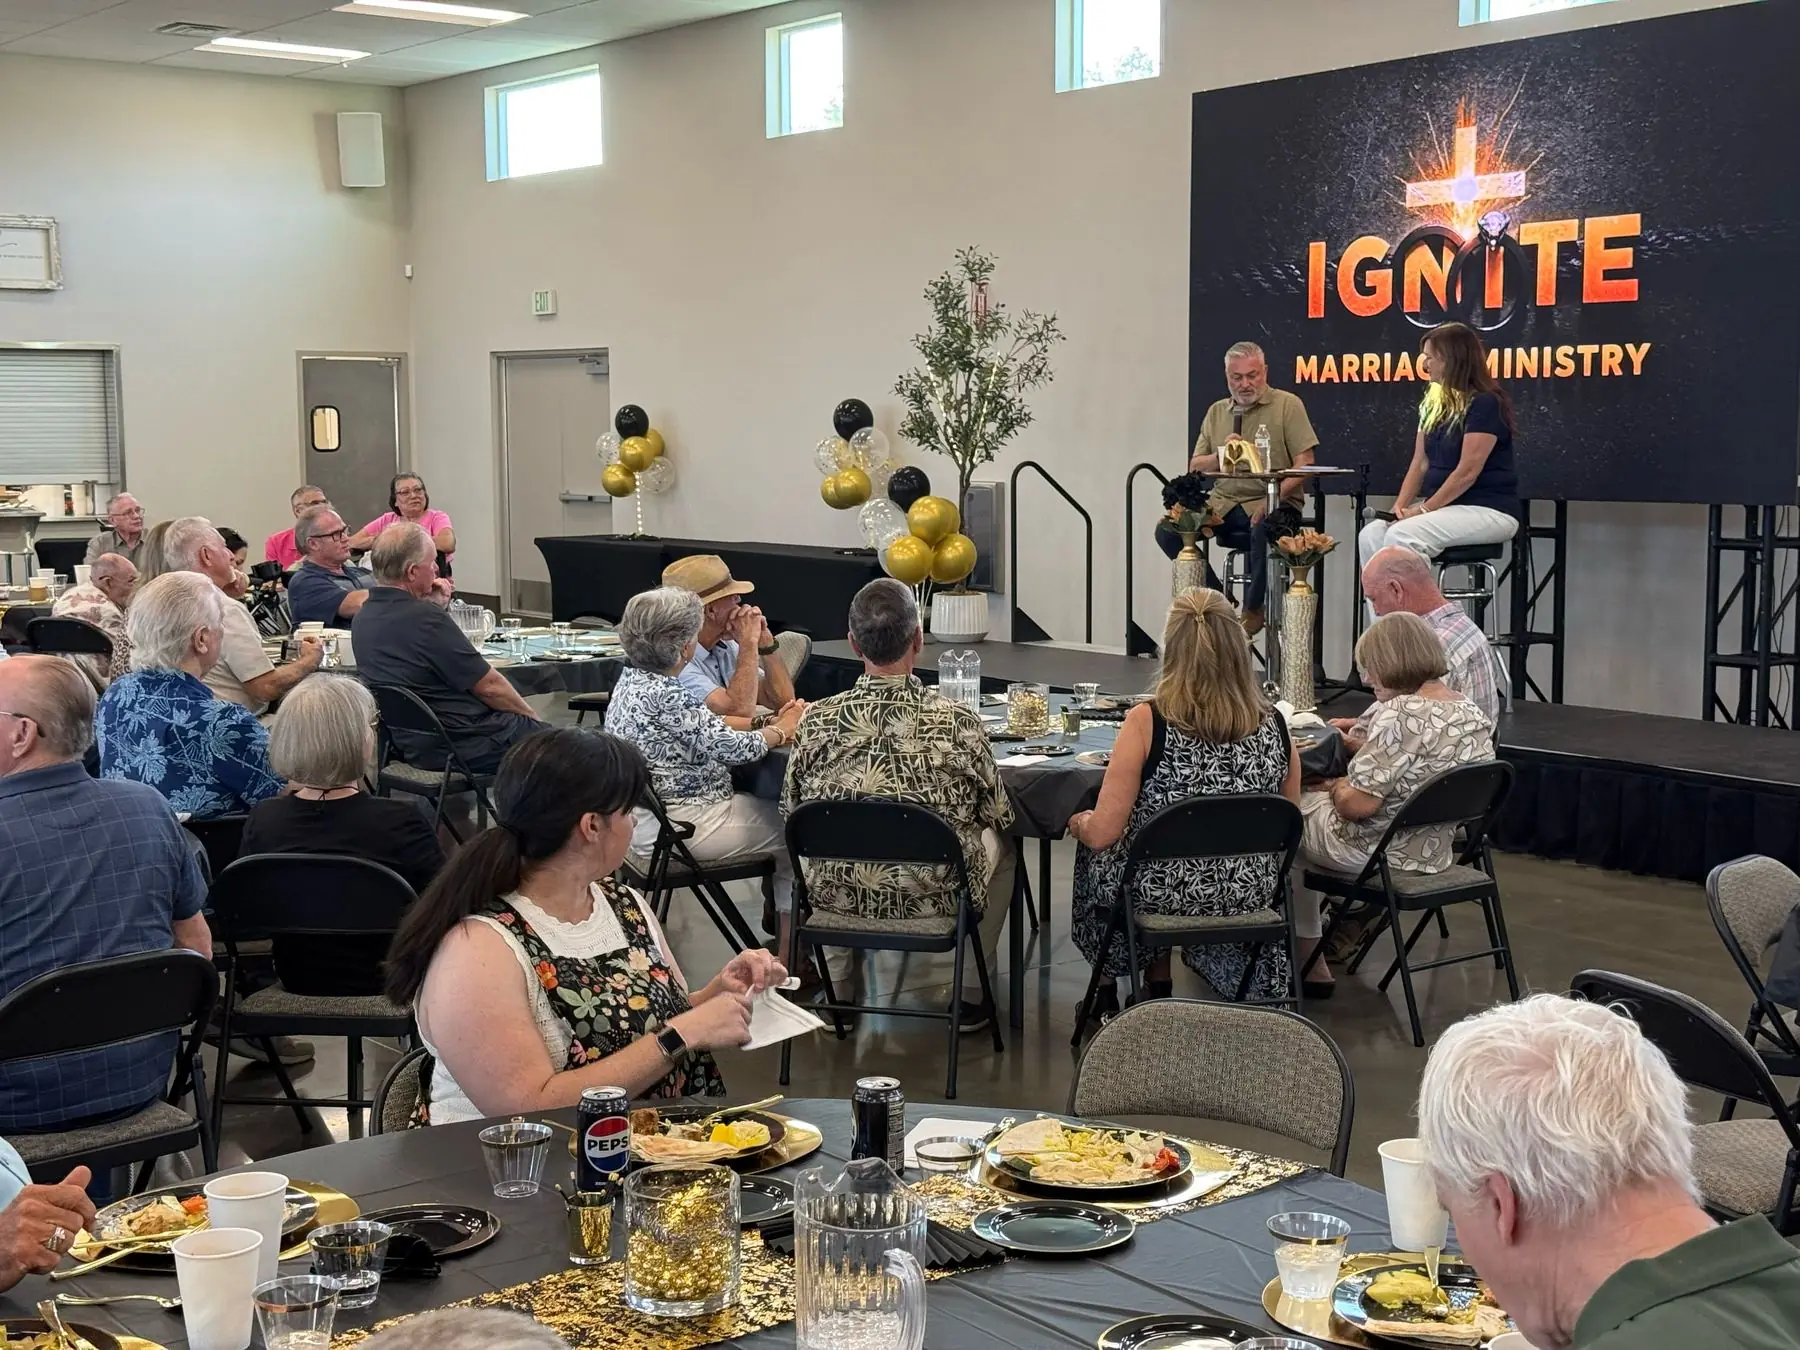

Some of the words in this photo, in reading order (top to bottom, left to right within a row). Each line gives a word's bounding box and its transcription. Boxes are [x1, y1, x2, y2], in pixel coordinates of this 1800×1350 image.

[1308, 213, 1641, 318] IGNITE
[535, 291, 549, 312] EXIT
[1295, 351, 1432, 384] MARRIAG
[587, 1136, 628, 1151] PEPS
